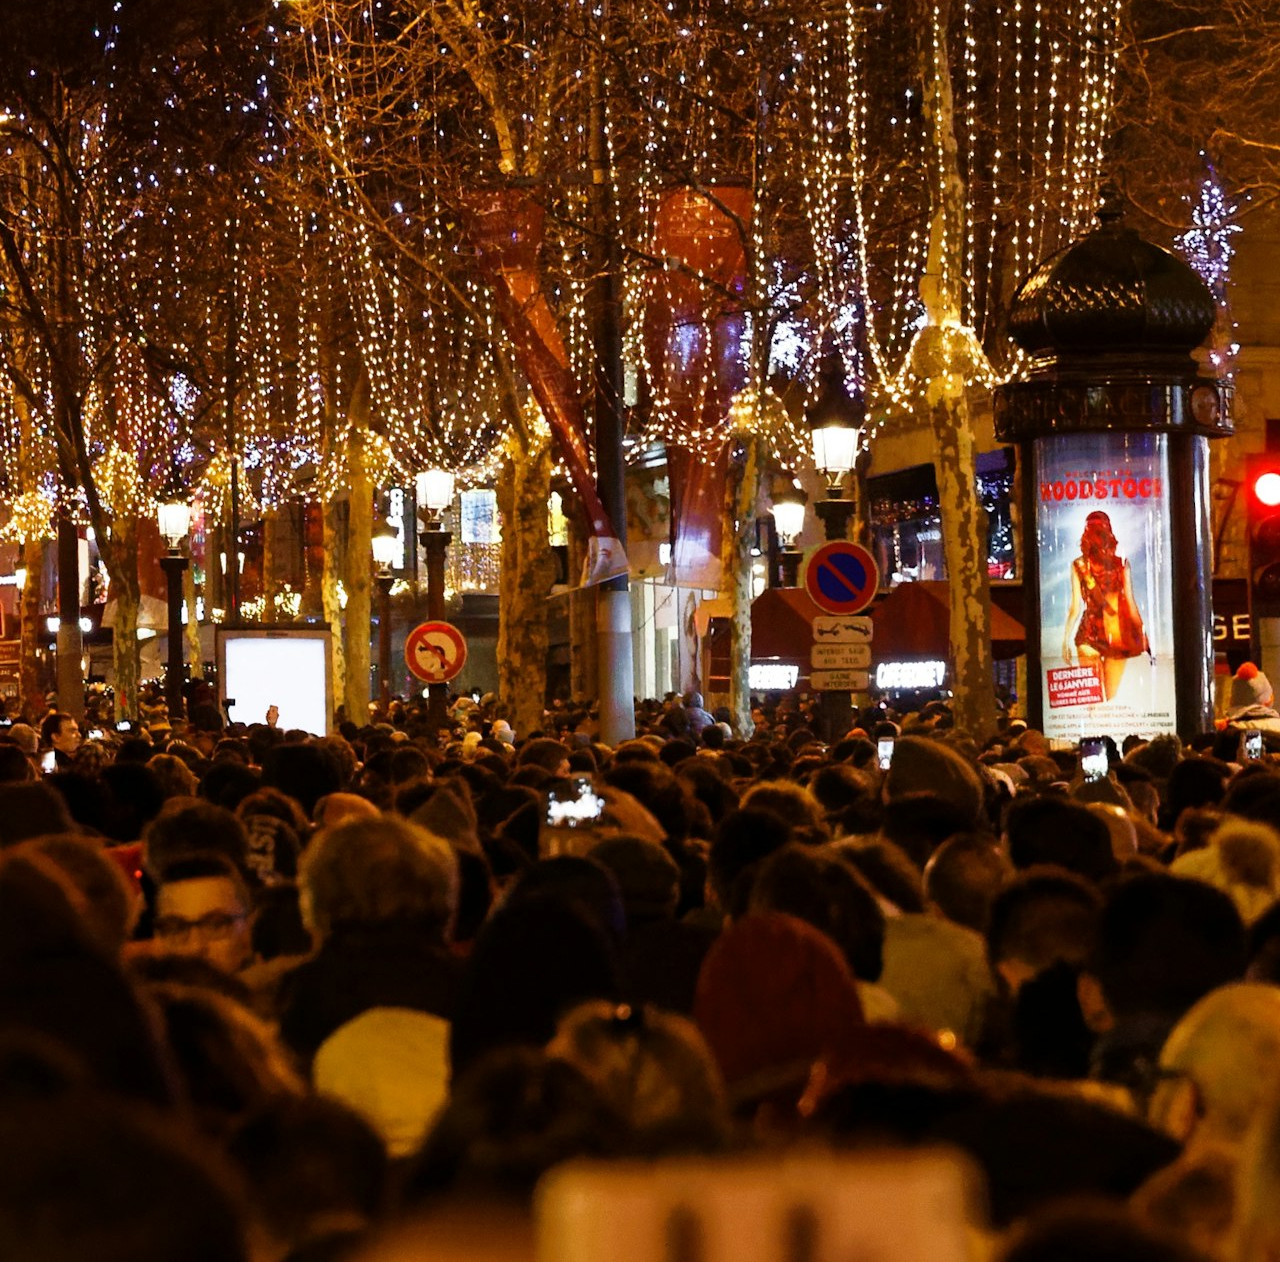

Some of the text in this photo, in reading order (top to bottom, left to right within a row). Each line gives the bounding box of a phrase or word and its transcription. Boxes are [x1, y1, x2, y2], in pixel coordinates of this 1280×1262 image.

[1052, 667, 1094, 681] DERNIÈRE
[1050, 682, 1058, 692] LE
[1064, 677, 1100, 691] JANVIER
